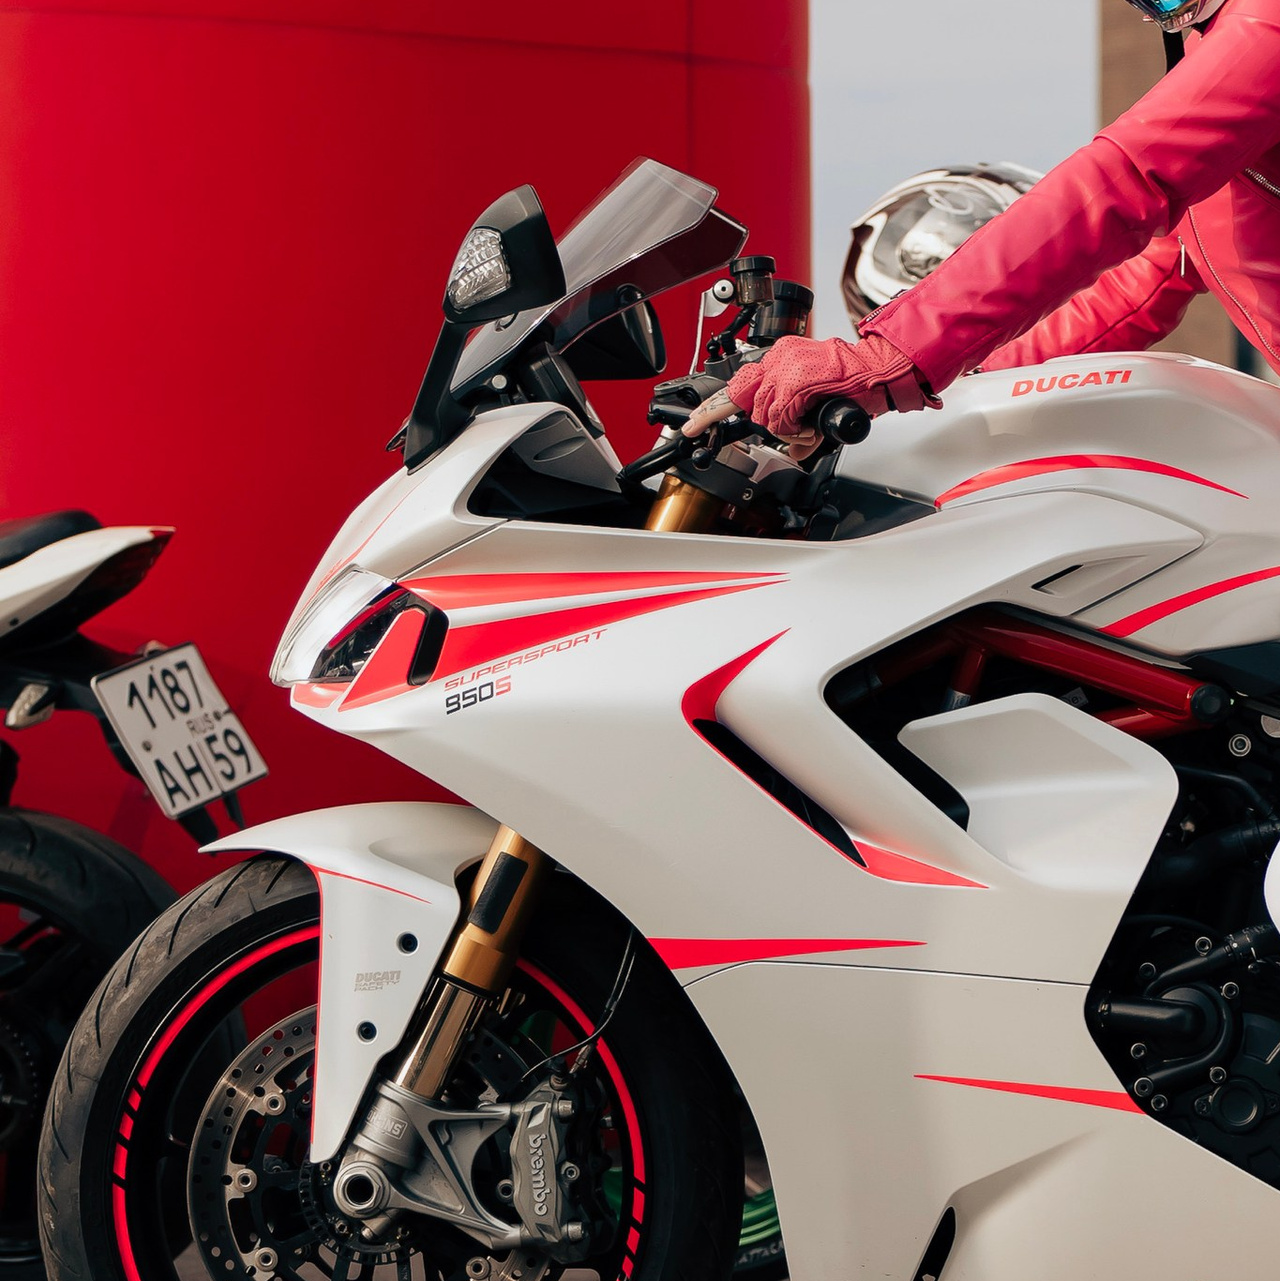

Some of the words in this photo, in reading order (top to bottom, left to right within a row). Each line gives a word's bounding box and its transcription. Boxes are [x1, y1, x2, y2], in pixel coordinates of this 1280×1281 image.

[1011, 369, 1133, 398] DUCATI
[444, 628, 608, 691] SUPERSPORT
[127, 660, 204, 729] 1187
[445, 675, 512, 715] 950S
[204, 728, 252, 781] 59
[355, 970, 402, 983] DUCATI
[528, 1133, 553, 1217] brembo
